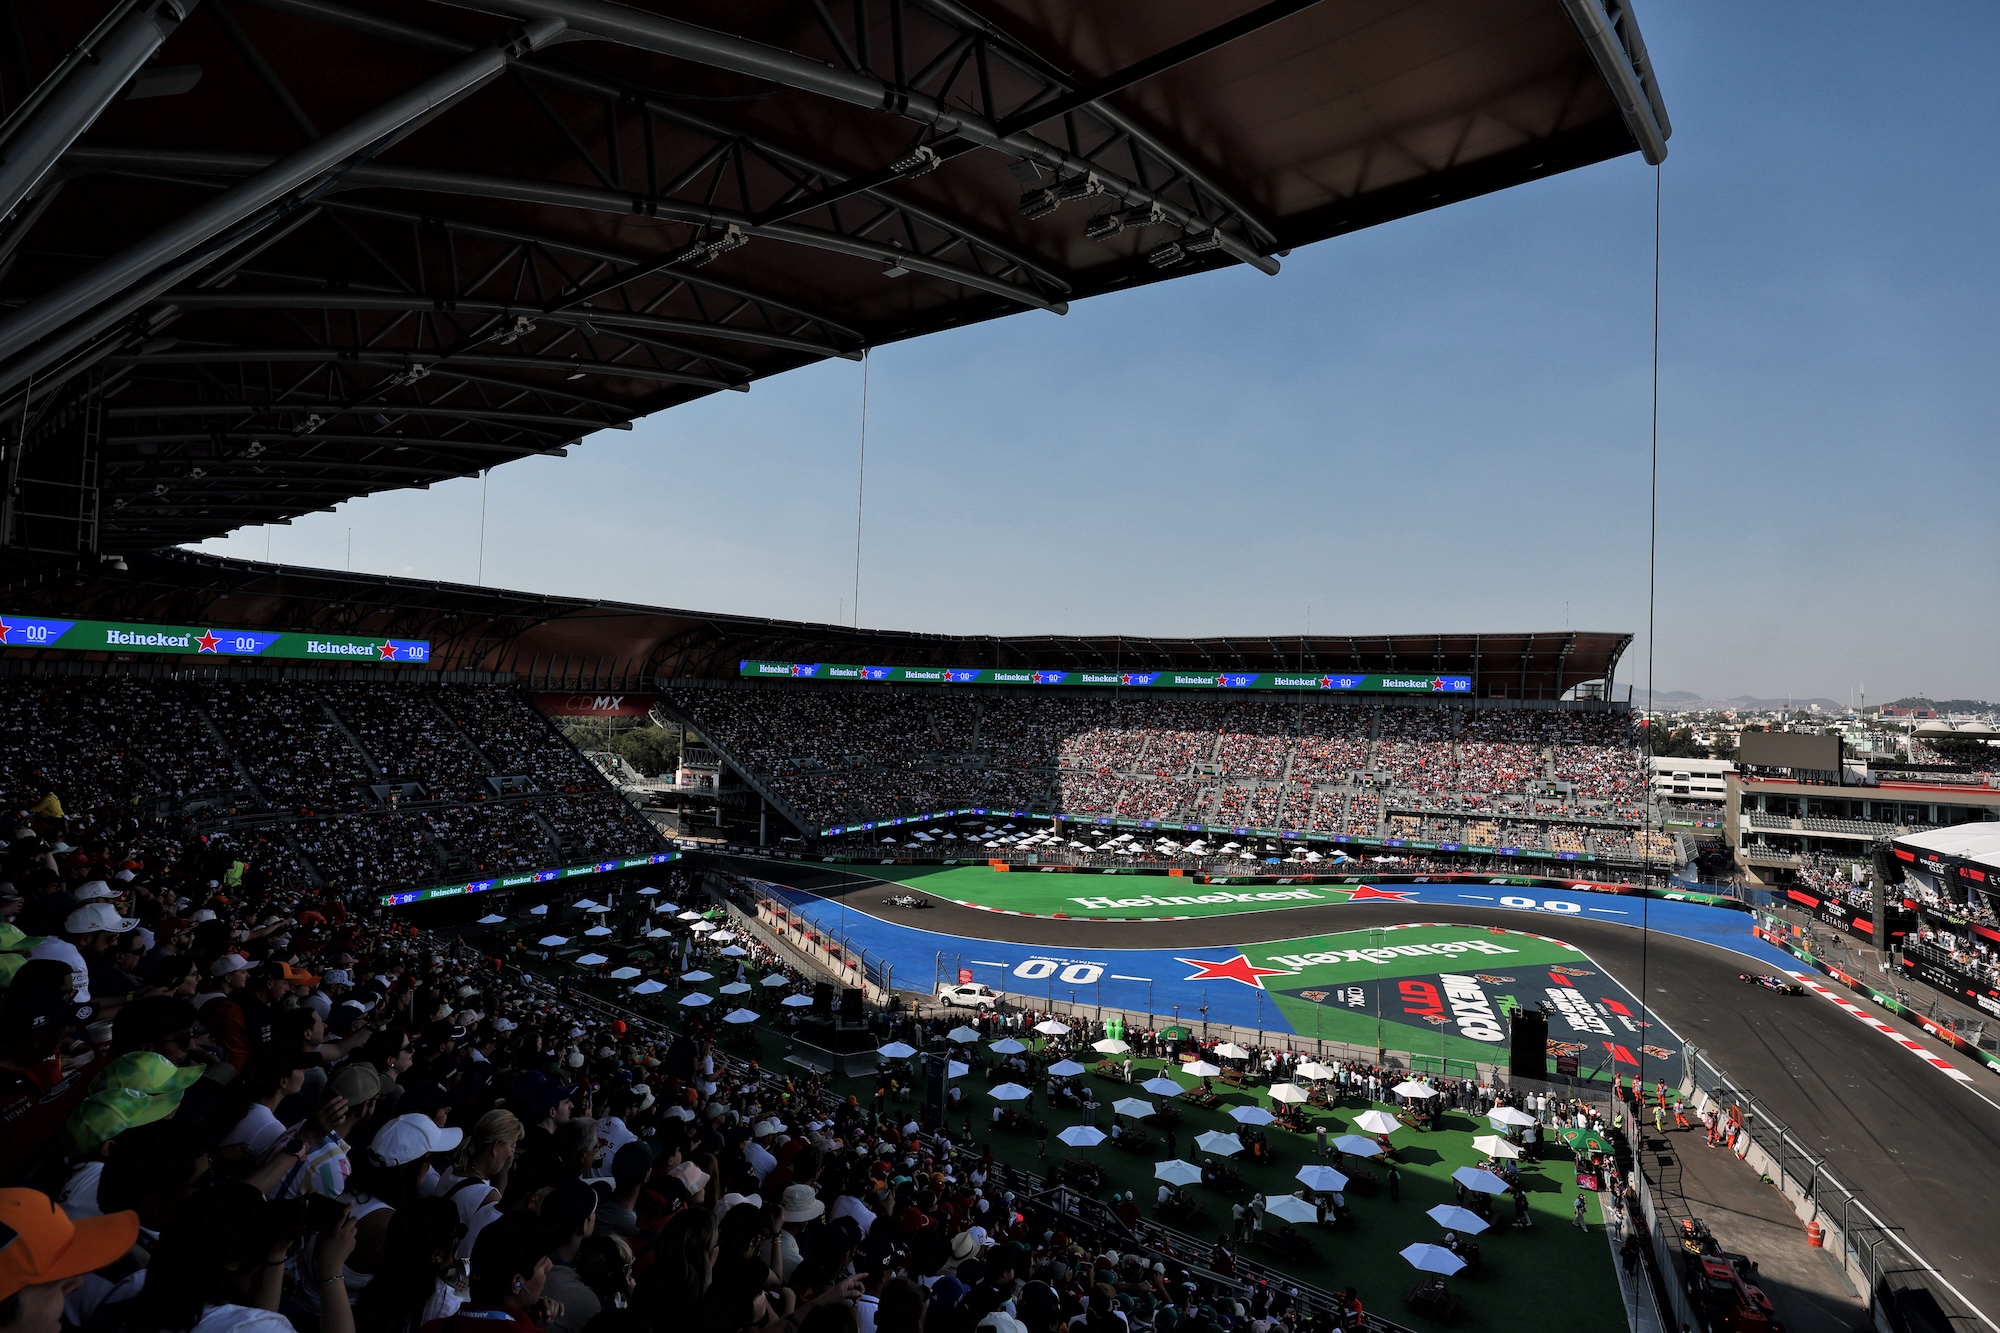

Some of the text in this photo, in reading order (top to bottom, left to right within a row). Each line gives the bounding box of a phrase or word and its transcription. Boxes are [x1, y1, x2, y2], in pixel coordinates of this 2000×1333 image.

[106, 629, 191, 647] Heineken
[306, 640, 375, 656] Heineken
[566, 696, 624, 711] CDMX
[1067, 888, 1325, 909] Heineken
[1500, 896, 1582, 913] 0.0
[122, 920, 132, 928] 44
[1821, 912, 1850, 932] ESTADIO
[1267, 940, 1519, 971] Heineken
[1398, 980, 1447, 1019] CITY
[1438, 973, 1506, 1042] MEXICO
[1583, 1015, 1616, 1037] CITY
